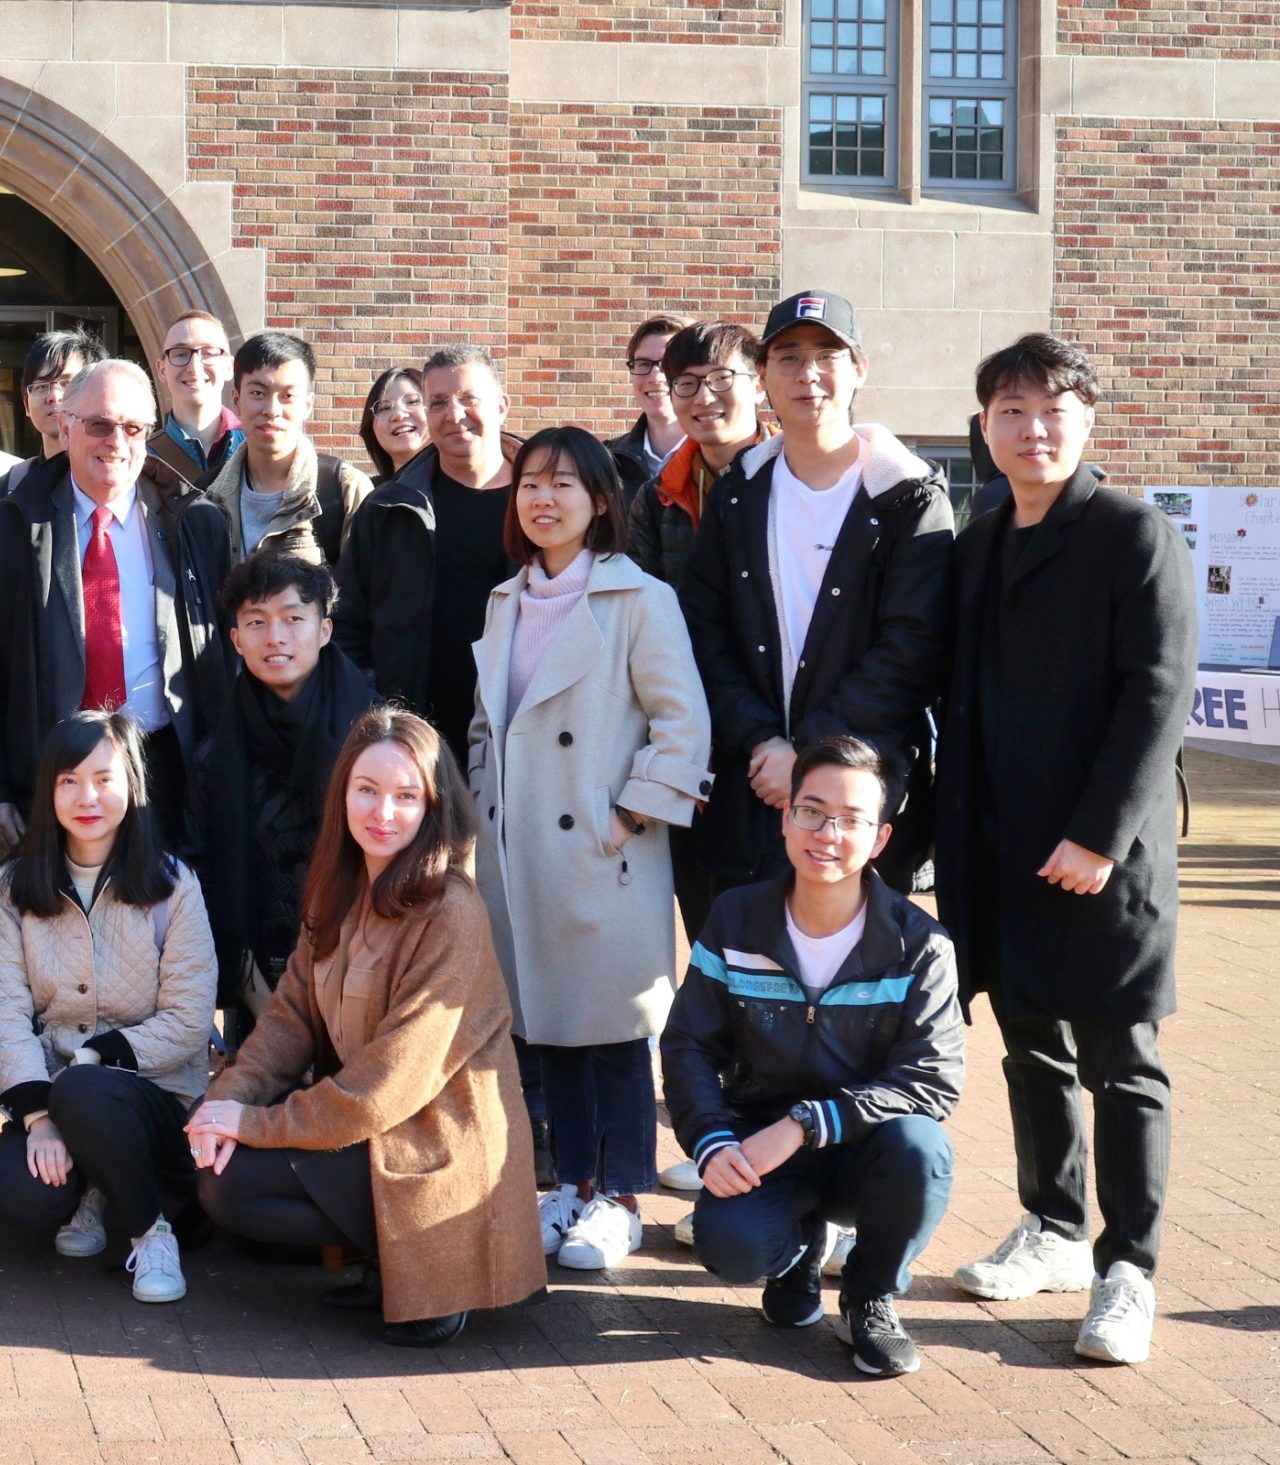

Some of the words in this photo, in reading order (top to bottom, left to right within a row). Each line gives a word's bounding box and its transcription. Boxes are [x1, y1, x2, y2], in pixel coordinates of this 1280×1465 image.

[1245, 511, 1280, 528] Chapte
[1186, 687, 1248, 730] REE
[1261, 688, 1280, 728] H
